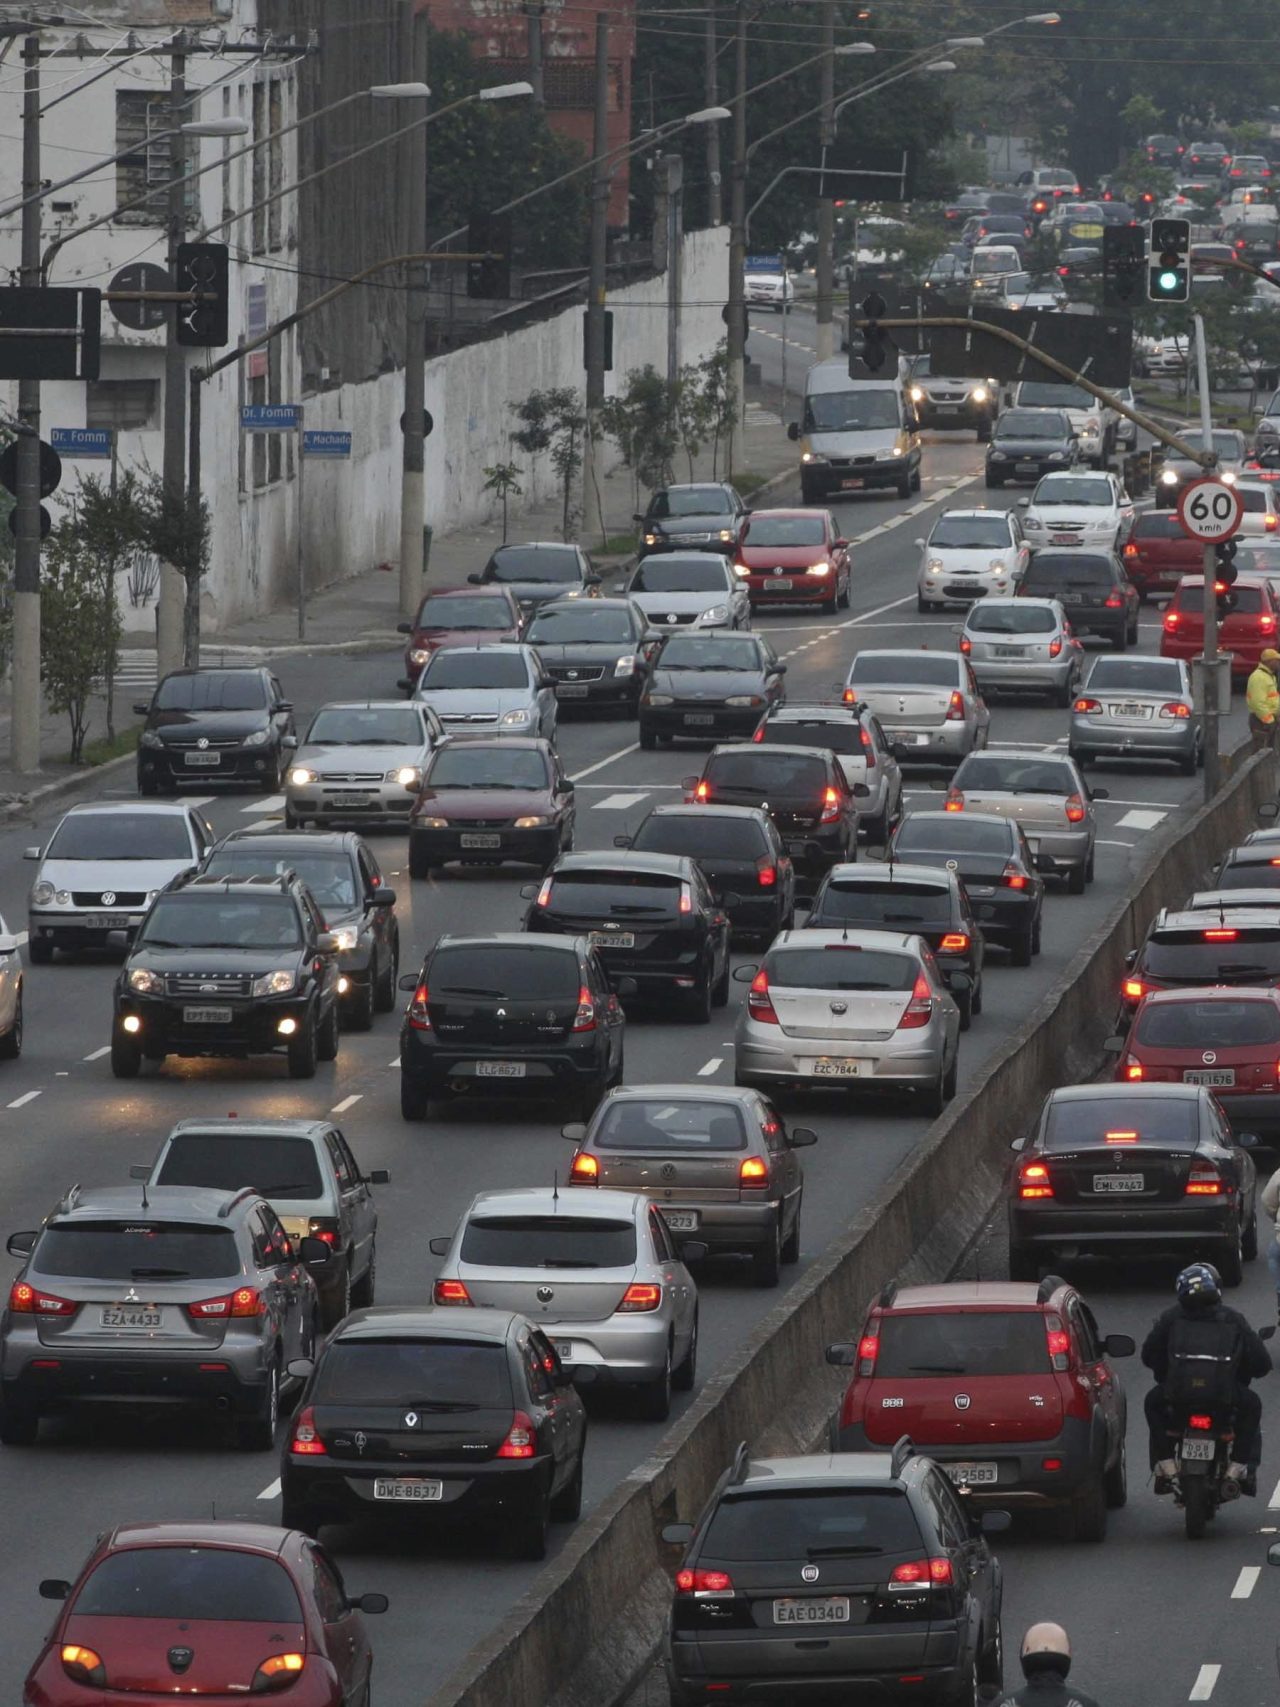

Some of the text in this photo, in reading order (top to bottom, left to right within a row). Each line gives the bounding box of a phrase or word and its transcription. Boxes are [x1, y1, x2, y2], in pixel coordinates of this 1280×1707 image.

[242, 407, 294, 418] Dr. Fomm
[52, 430, 106, 443] Dr. Fomm
[1190, 492, 1232, 520] 60
[1198, 523, 1223, 533] km/h
